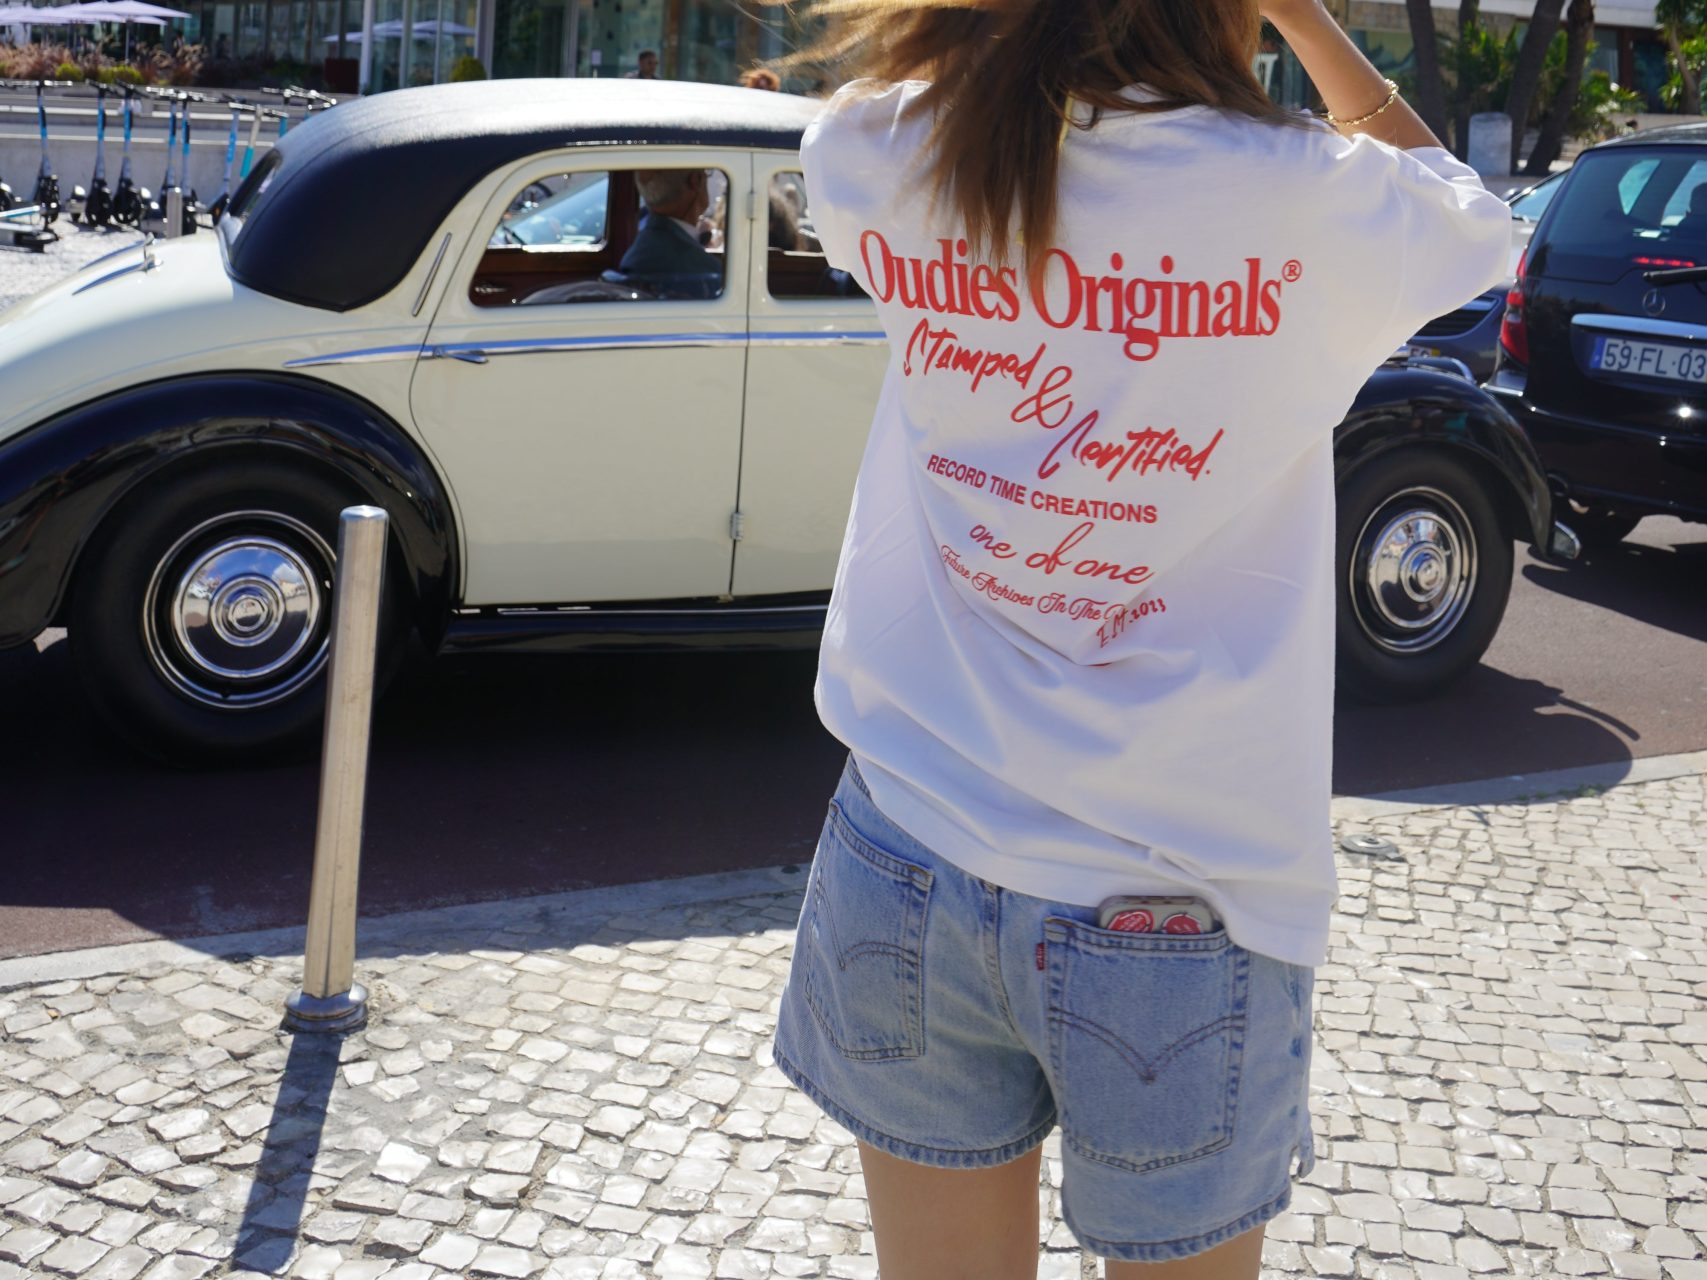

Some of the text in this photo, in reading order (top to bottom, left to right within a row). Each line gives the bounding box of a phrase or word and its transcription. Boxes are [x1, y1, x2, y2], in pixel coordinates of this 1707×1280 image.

[860, 229, 1020, 322] Oudies
[904, 318, 1073, 429] Stamped &
[927, 454, 1158, 524] RECORD TIME CREATIONS
[941, 544, 970, 579] Future
[971, 571, 1034, 607] Archives
[1037, 592, 1067, 614] In
[1068, 597, 1108, 621] The
[969, 521, 1156, 585] one of one
